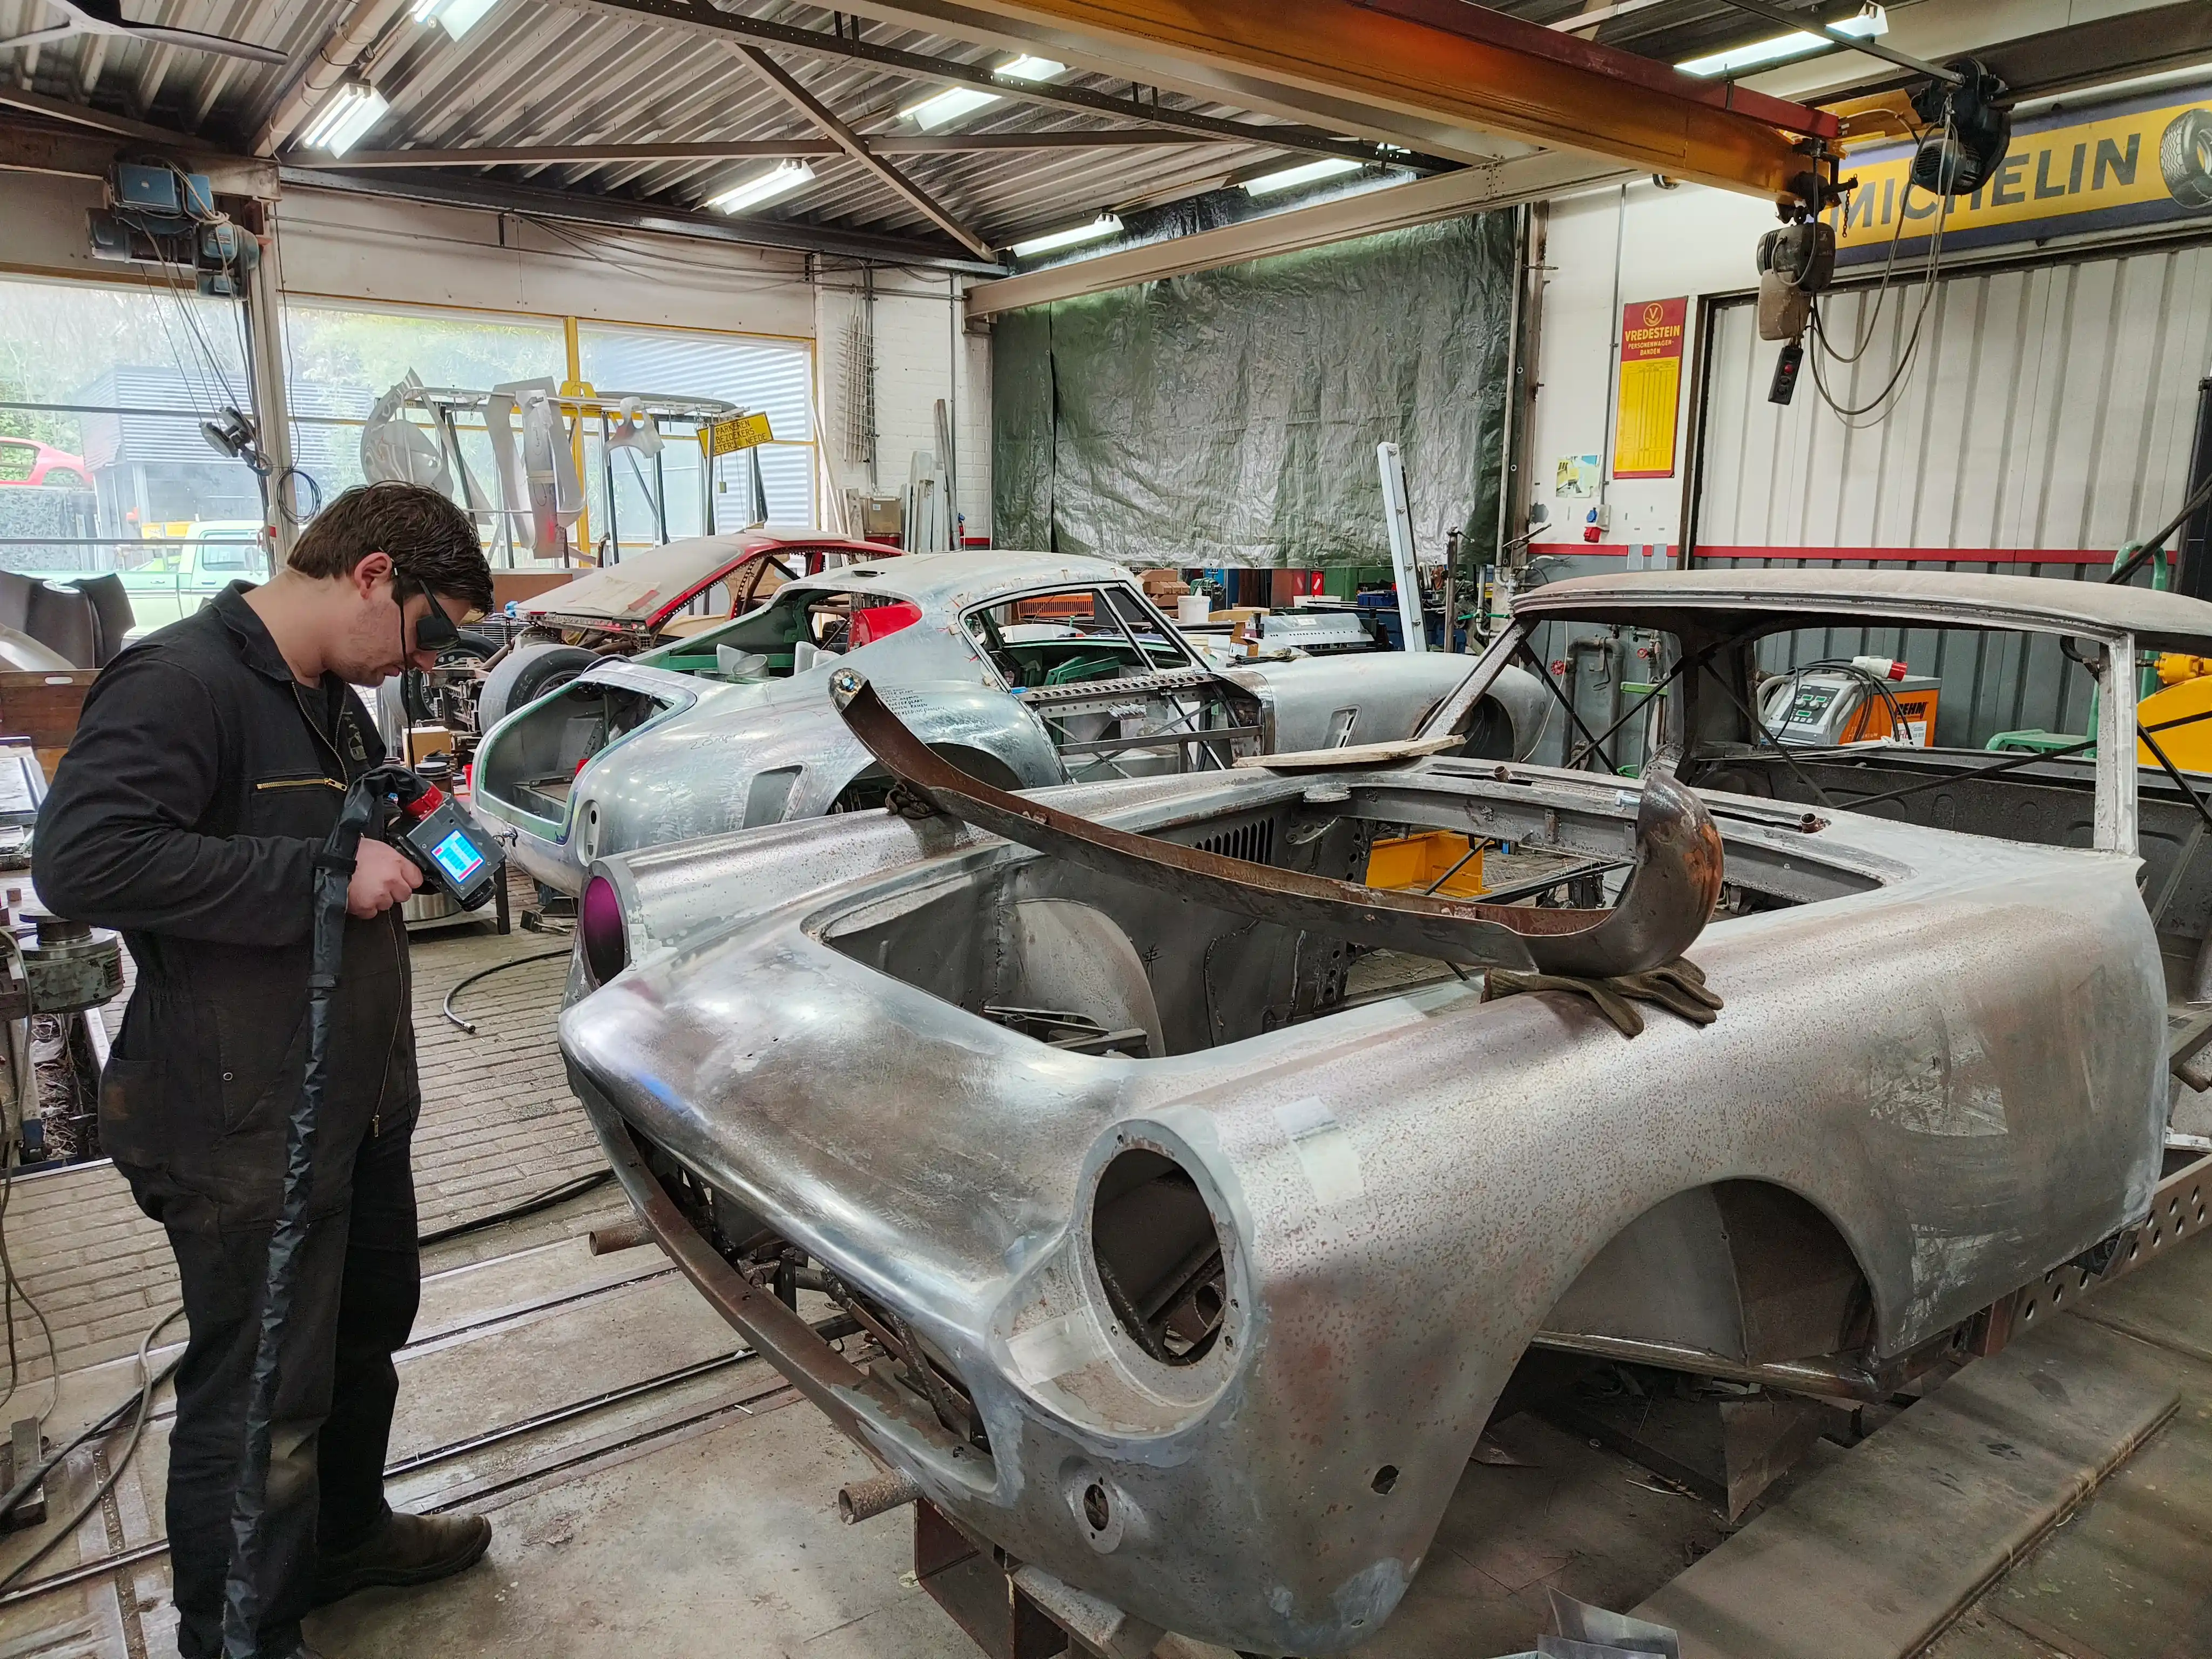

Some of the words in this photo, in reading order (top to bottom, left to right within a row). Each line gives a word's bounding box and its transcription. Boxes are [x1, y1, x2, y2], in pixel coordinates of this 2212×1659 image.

[1625, 325, 1681, 341] VREDESTEIN
[716, 420, 750, 435] PARKEREN
[716, 427, 754, 444] BEZOEKERS
[713, 440, 737, 454] ETERIJ
[745, 433, 767, 445] NEEDE
